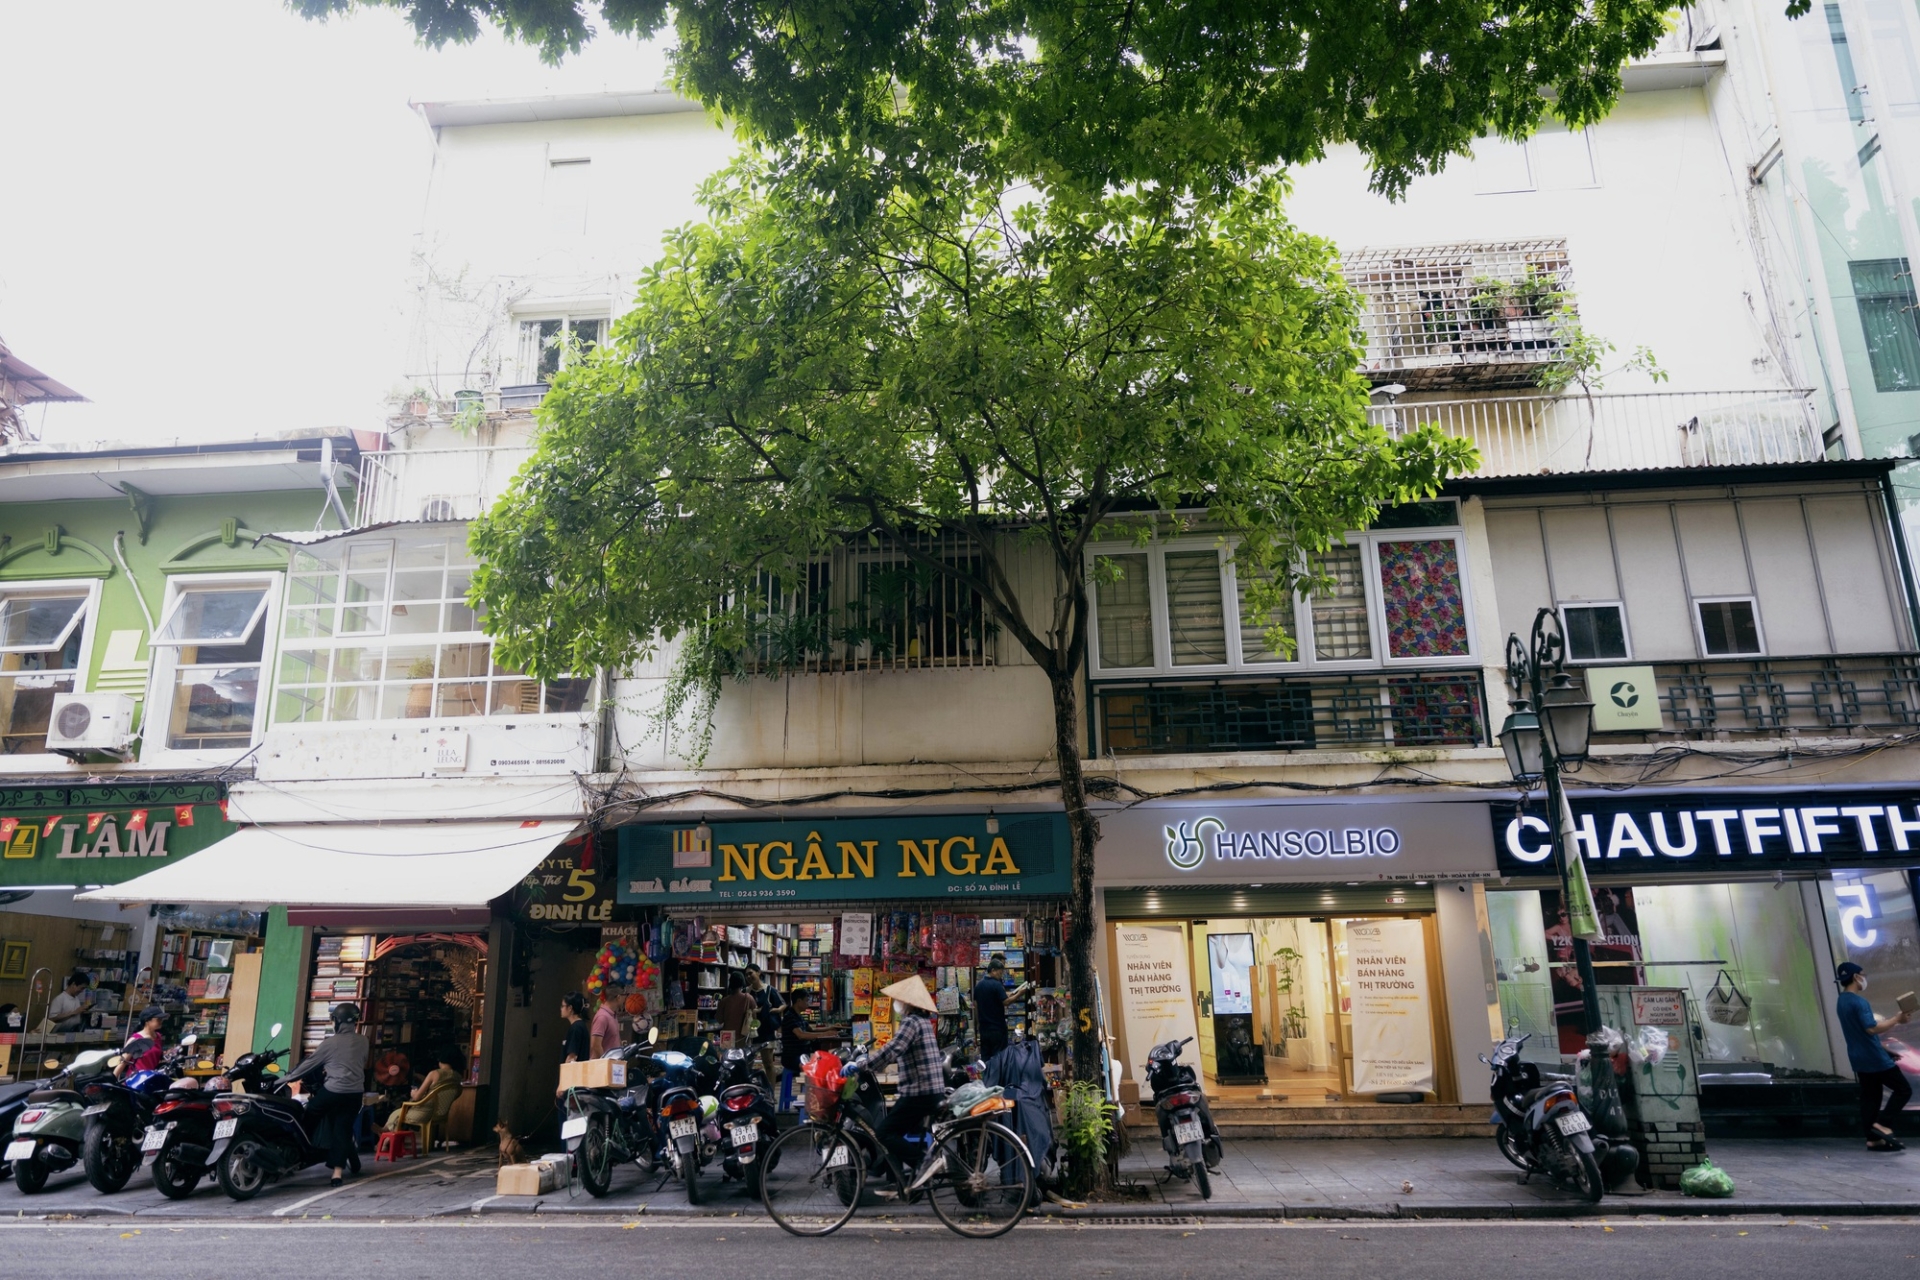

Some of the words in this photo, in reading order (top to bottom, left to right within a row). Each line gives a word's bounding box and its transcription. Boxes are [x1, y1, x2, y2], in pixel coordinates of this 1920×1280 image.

[56, 815, 171, 858] LÂM
[1215, 828, 1400, 858] HANSOLBIO
[718, 831, 879, 882] NGÂN
[897, 836, 1020, 877] NGA
[548, 859, 556, 869] Y
[563, 868, 595, 901] 5
[629, 877, 666, 893] NHÀ
[669, 877, 712, 893] SÁCH
[965, 881, 976, 892] SỐ
[978, 884, 987, 892] 7A
[737, 890, 757, 898] 0243
[759, 889, 774, 897] 936
[776, 889, 796, 897] 3590
[602, 925, 637, 936] KHÁCH
[1551, 935, 1573, 946] Y2K
[1126, 960, 1151, 971] NHÂN
[1152, 960, 1172, 970] VIÊN
[1356, 955, 1383, 965] NHÂN
[1384, 955, 1407, 965] VIÊN
[1128, 973, 1145, 983] BÁN
[1147, 972, 1172, 982] HÀNG
[1357, 968, 1376, 977] BÁN
[1378, 967, 1405, 977] HÀNG
[1129, 987, 1144, 996] THỊ
[1144, 983, 1181, 995] TRƯỜNG
[1358, 981, 1373, 991] THỊ
[1375, 979, 1415, 989] TRƯỜNG
